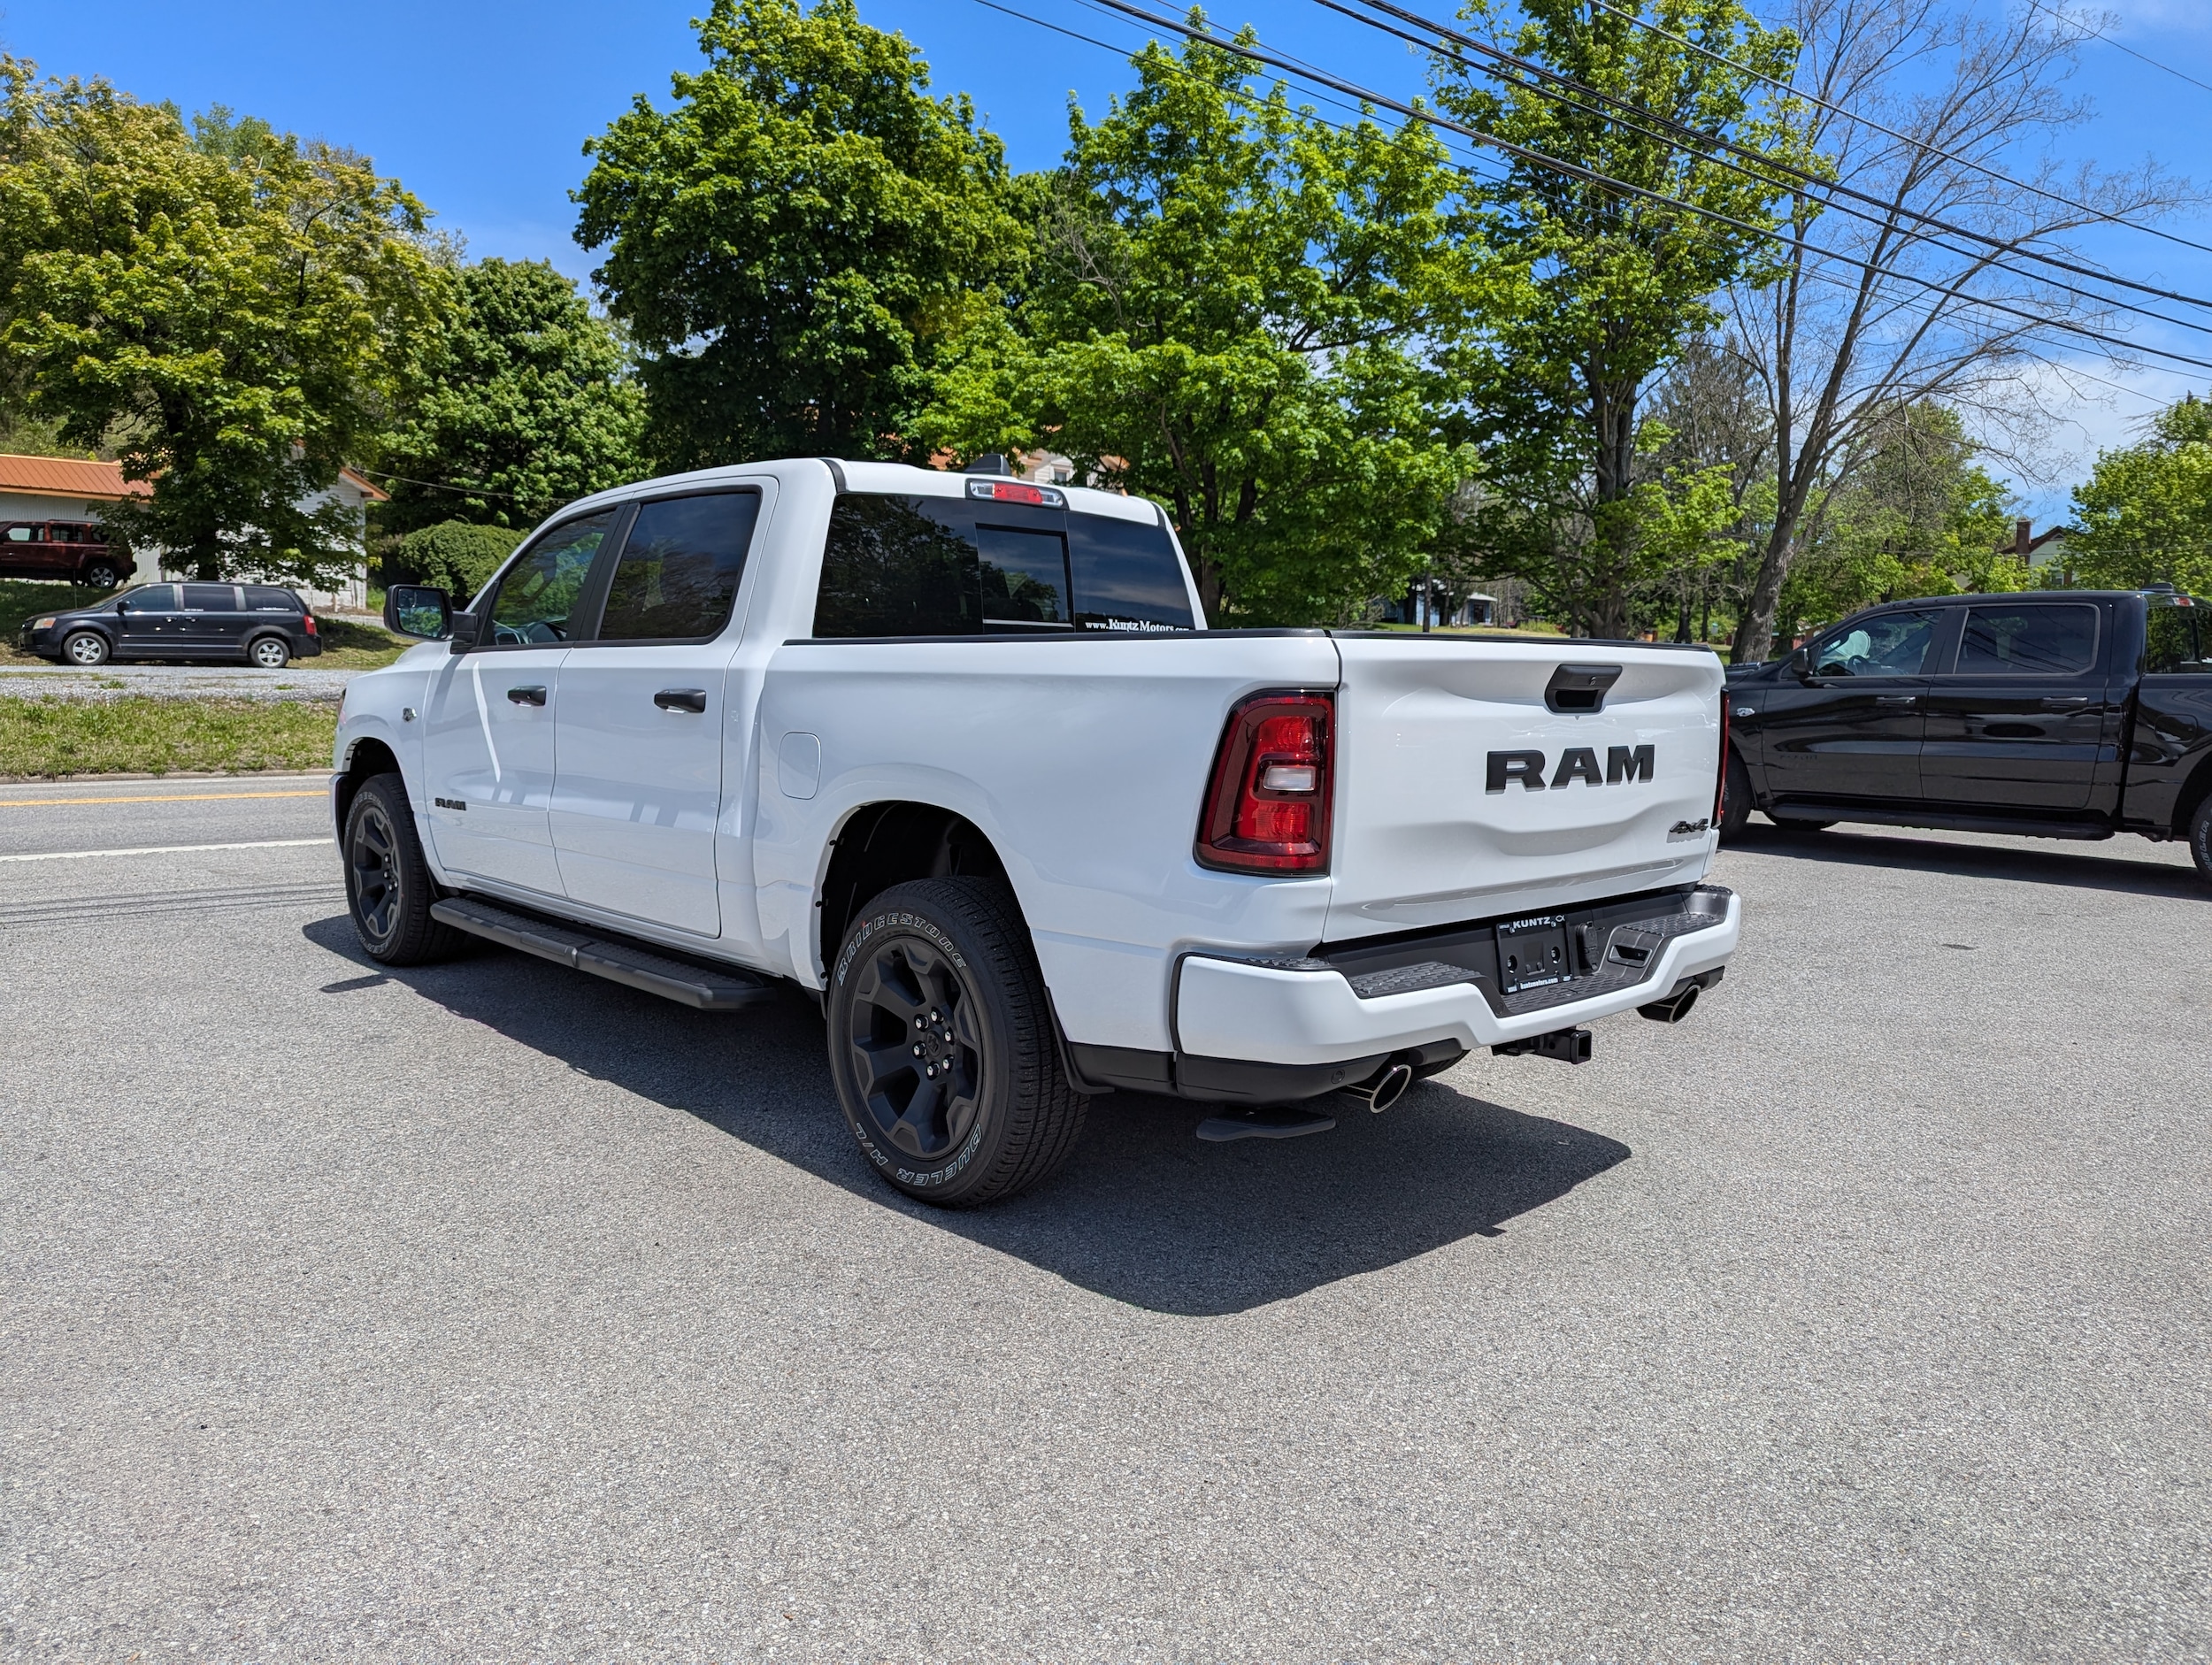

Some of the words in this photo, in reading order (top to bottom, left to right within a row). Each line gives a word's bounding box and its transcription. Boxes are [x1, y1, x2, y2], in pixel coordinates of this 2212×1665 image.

[1486, 745, 1655, 790] RAM
[434, 797, 466, 811] RAM
[1513, 917, 1550, 929] KUNTZ
[837, 912, 967, 986] BRIDGESTONE
[856, 1122, 888, 1167] H/L
[896, 1123, 982, 1186] DUELER
